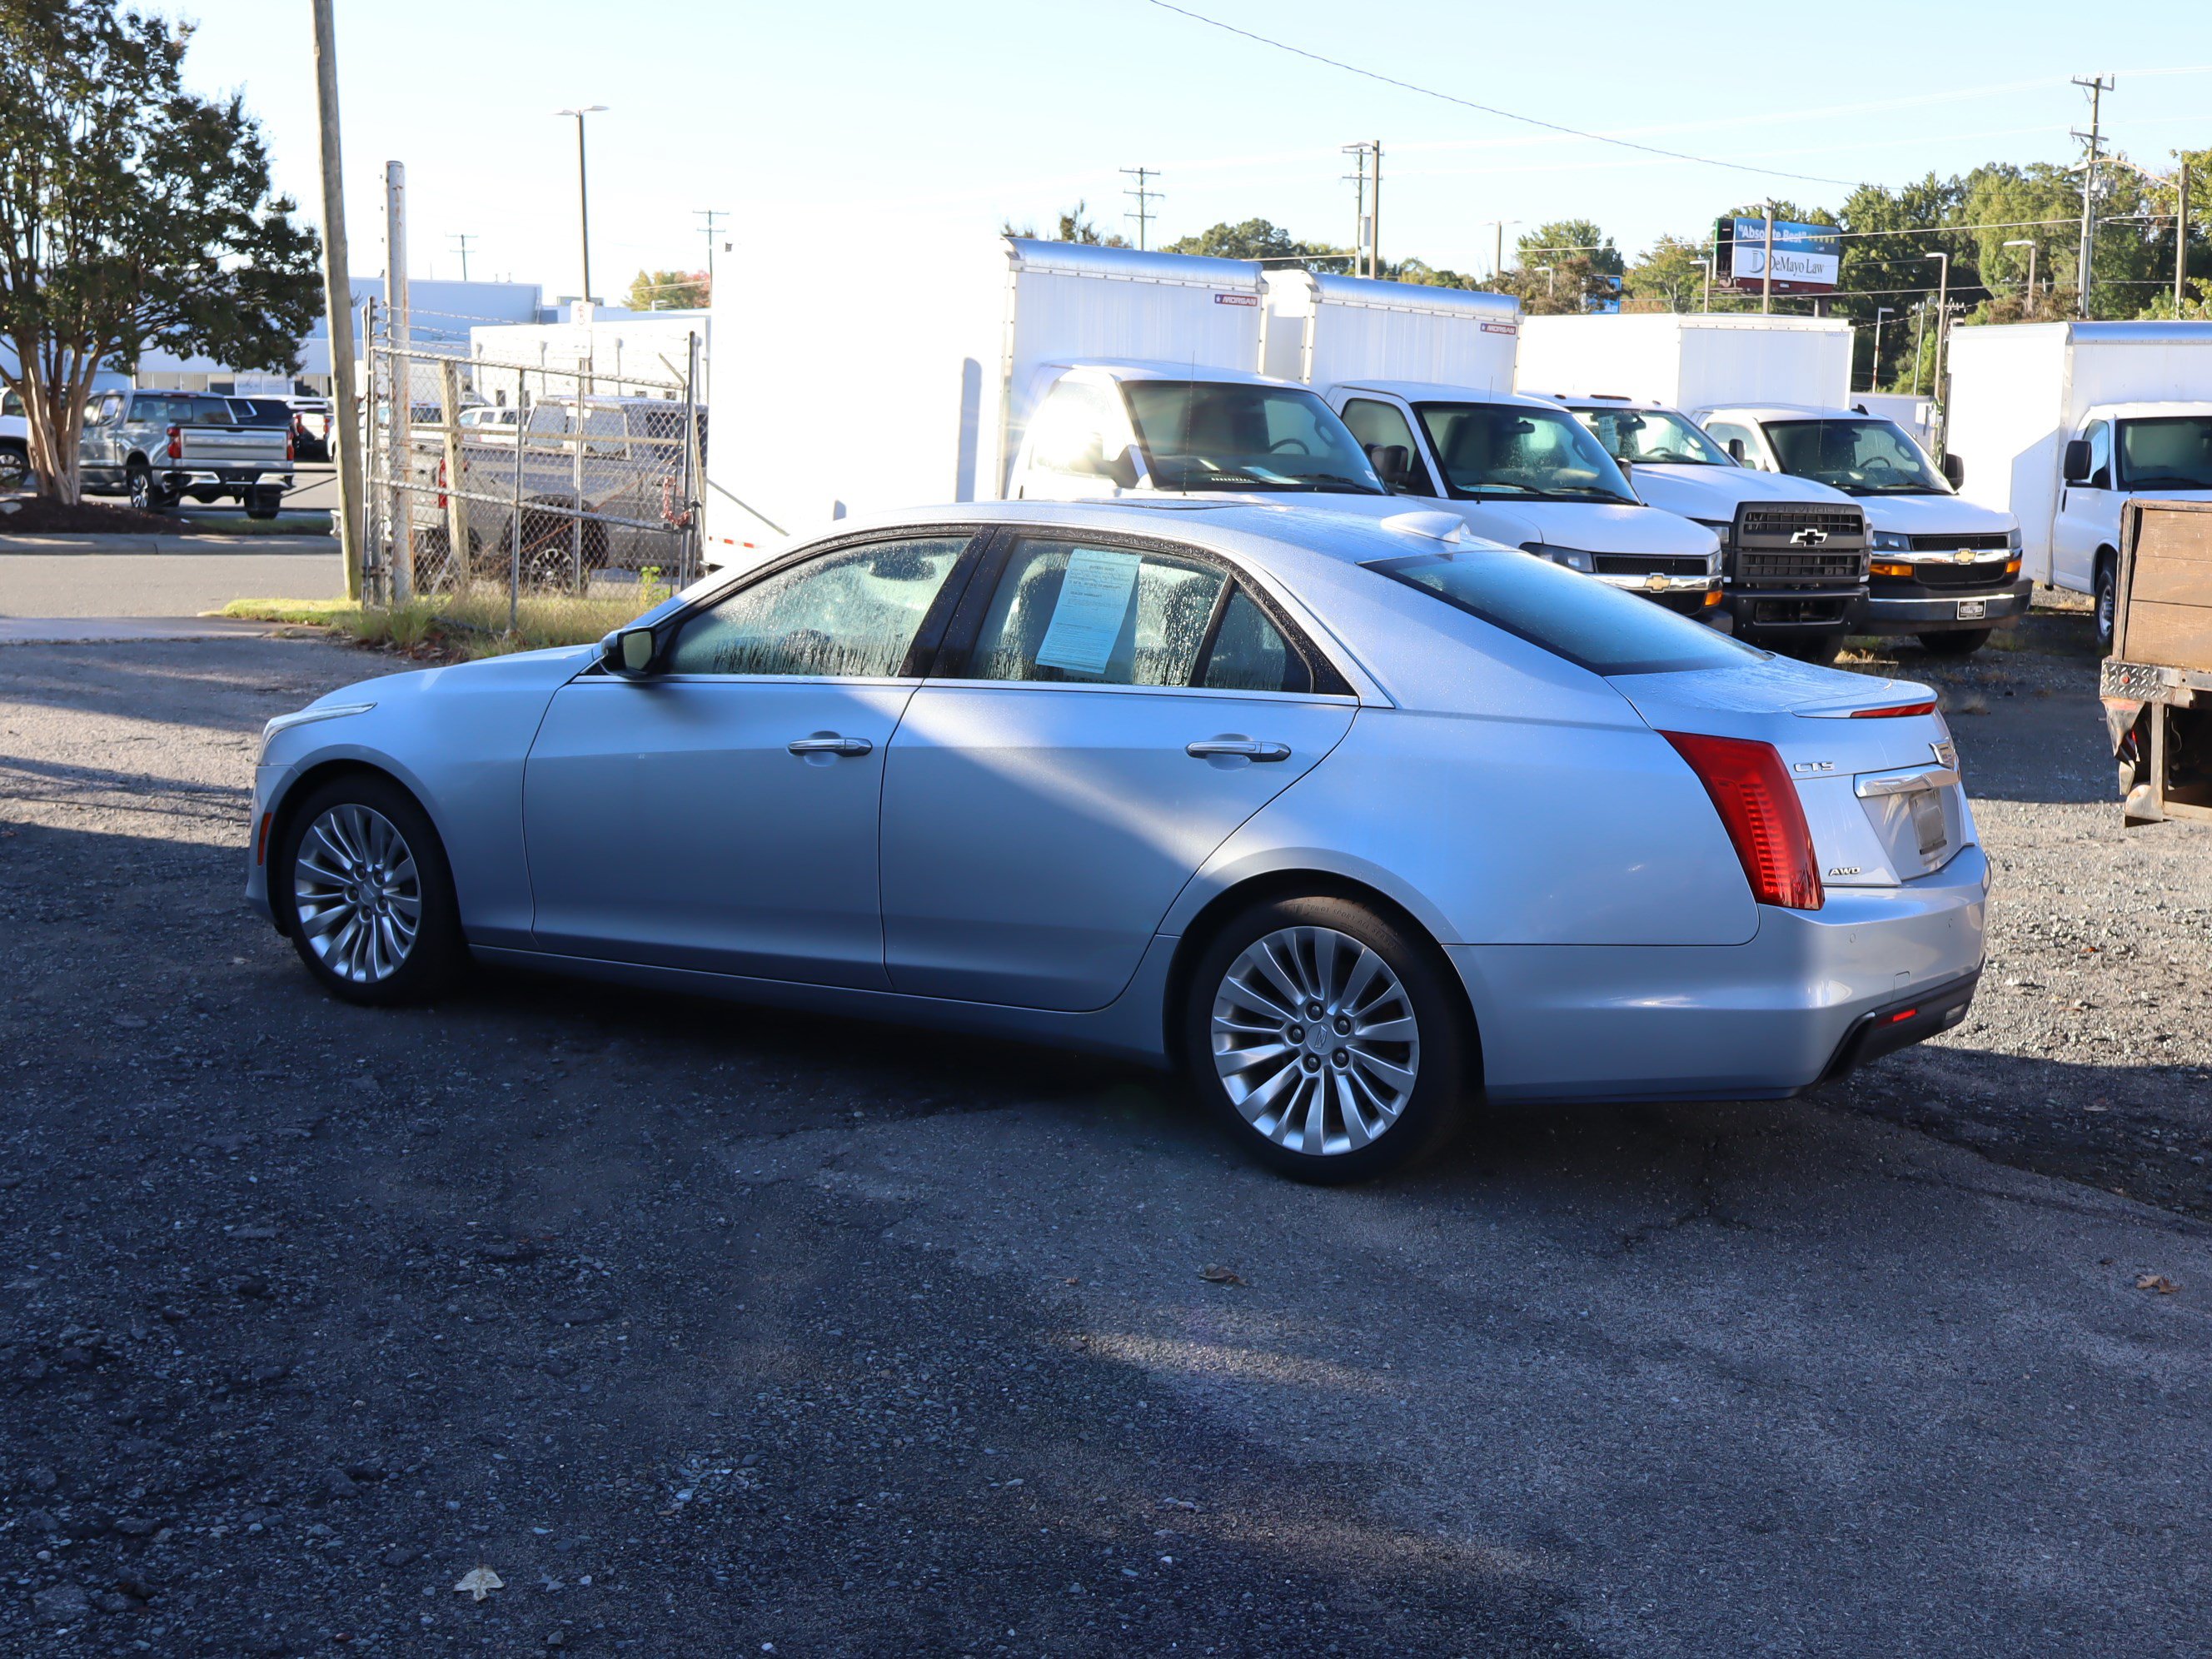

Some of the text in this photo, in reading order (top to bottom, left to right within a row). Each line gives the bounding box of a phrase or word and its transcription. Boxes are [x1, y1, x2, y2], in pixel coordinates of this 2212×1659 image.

[1738, 224, 1781, 240] "Absote
[1771, 255, 1824, 276] DeMayo Law
[1223, 296, 1257, 306] MORGAN
[1487, 325, 1515, 334] MORGAN
[1766, 506, 1847, 514] CHEVROLET
[1794, 761, 1836, 773] CTS
[1829, 867, 1861, 877] AWD
[1310, 904, 1330, 914] PILOT
[1333, 909, 1355, 921] SPORT
